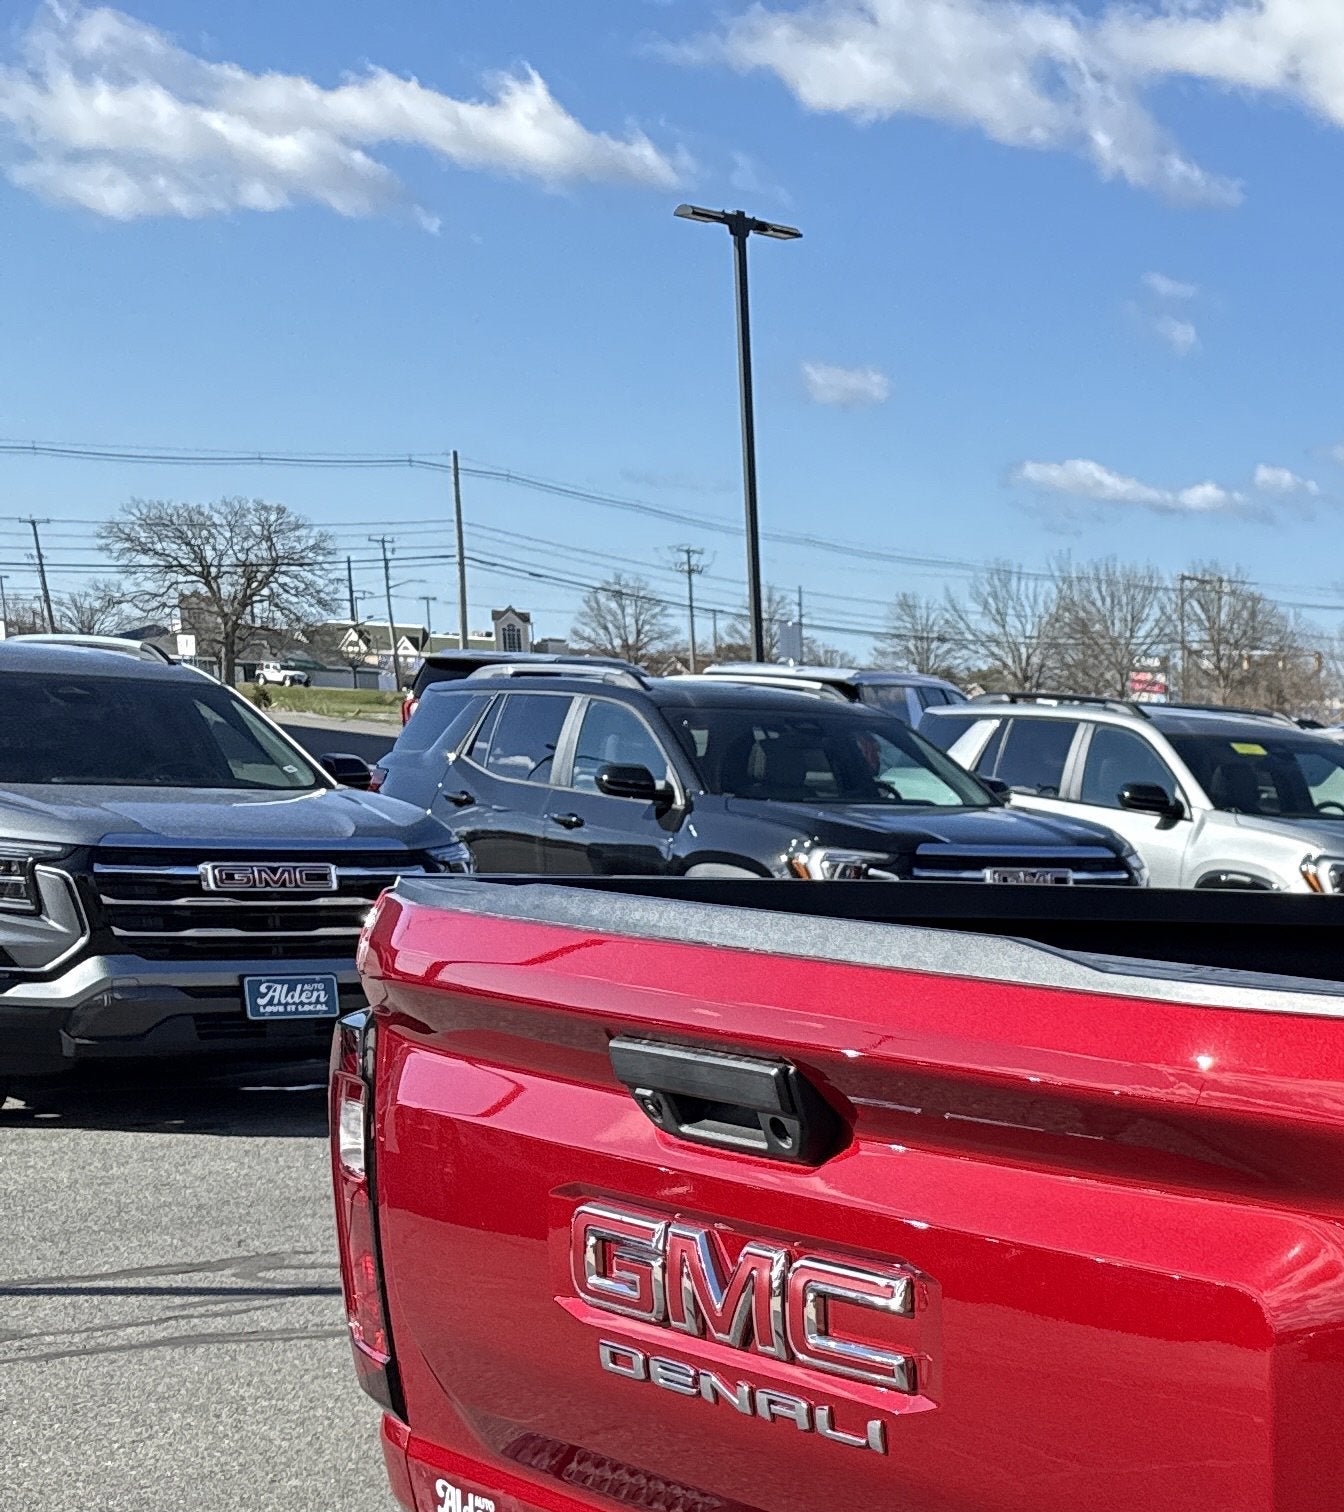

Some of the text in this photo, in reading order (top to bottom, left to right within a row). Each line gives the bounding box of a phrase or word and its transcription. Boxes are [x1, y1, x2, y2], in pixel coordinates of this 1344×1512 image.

[214, 865, 333, 888] GMC
[257, 983, 328, 1005] Alden
[303, 983, 325, 991] AUTO
[570, 1201, 918, 1394] GMC
[599, 1338, 888, 1454] DENALI
[475, 1495, 496, 1512] AUTO
